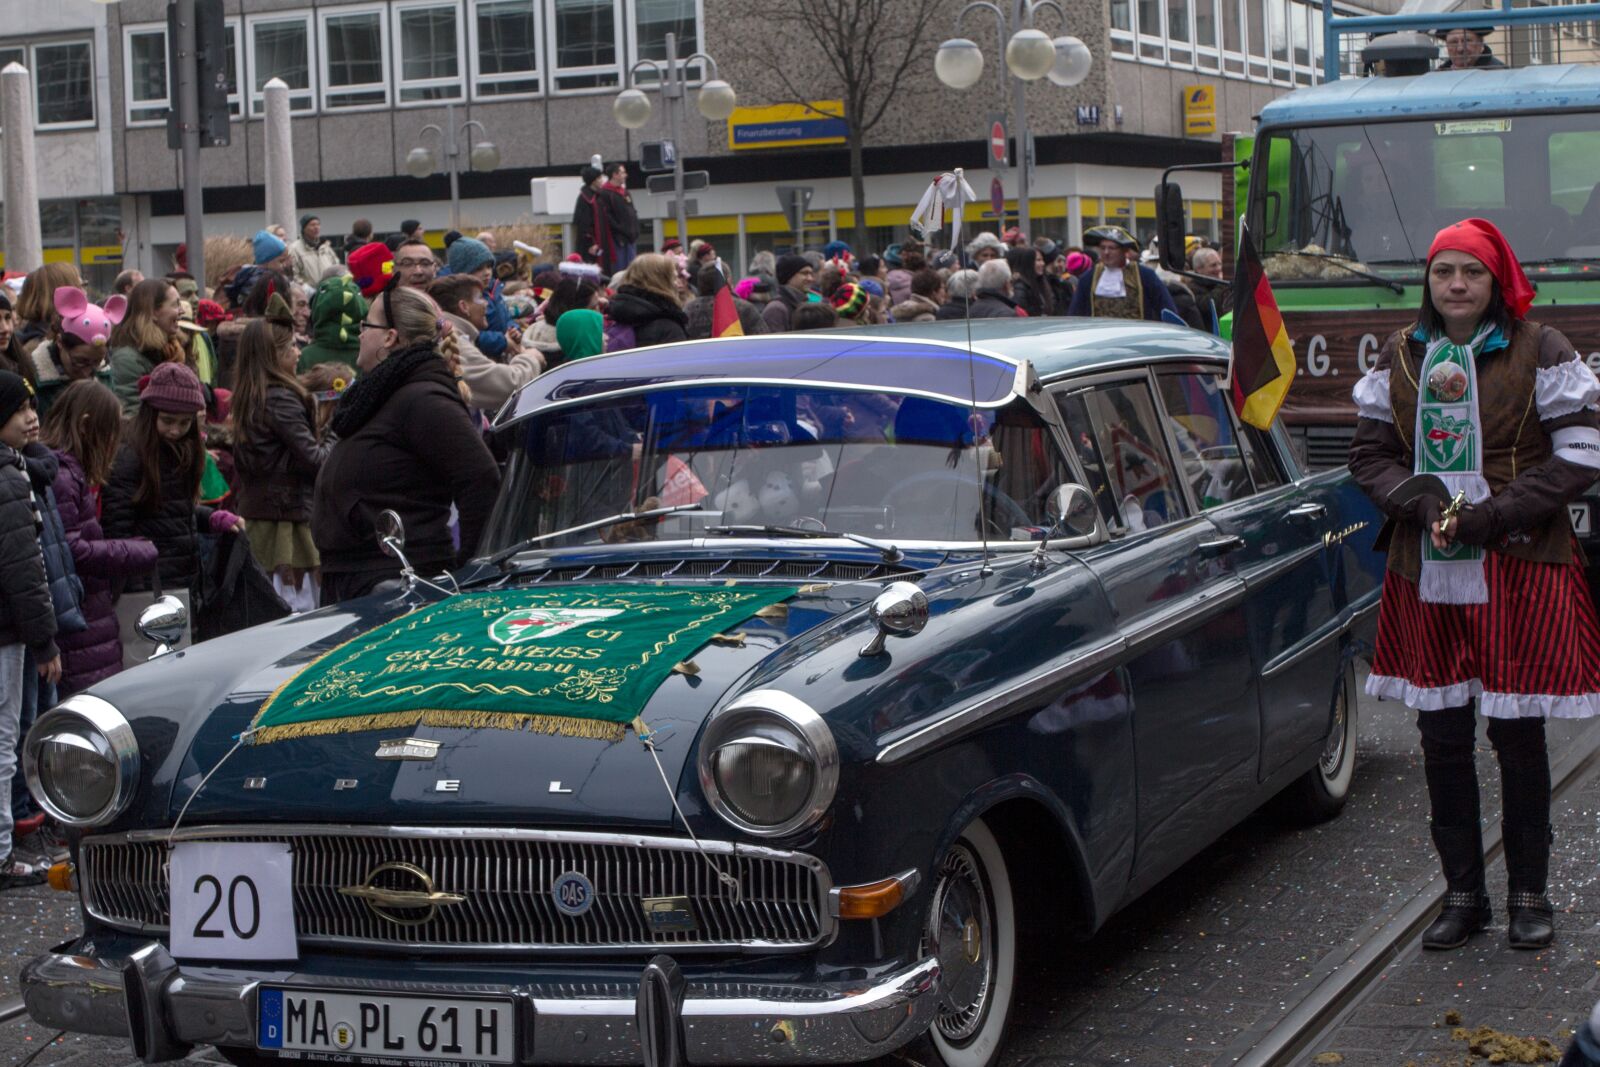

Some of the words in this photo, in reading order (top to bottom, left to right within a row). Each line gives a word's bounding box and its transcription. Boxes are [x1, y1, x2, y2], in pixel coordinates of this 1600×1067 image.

[737, 126, 802, 137] Finanzberatung
[562, 883, 585, 905] DAS
[193, 874, 260, 940] 20
[268, 1024, 277, 1039] D
[286, 998, 330, 1046] MA
